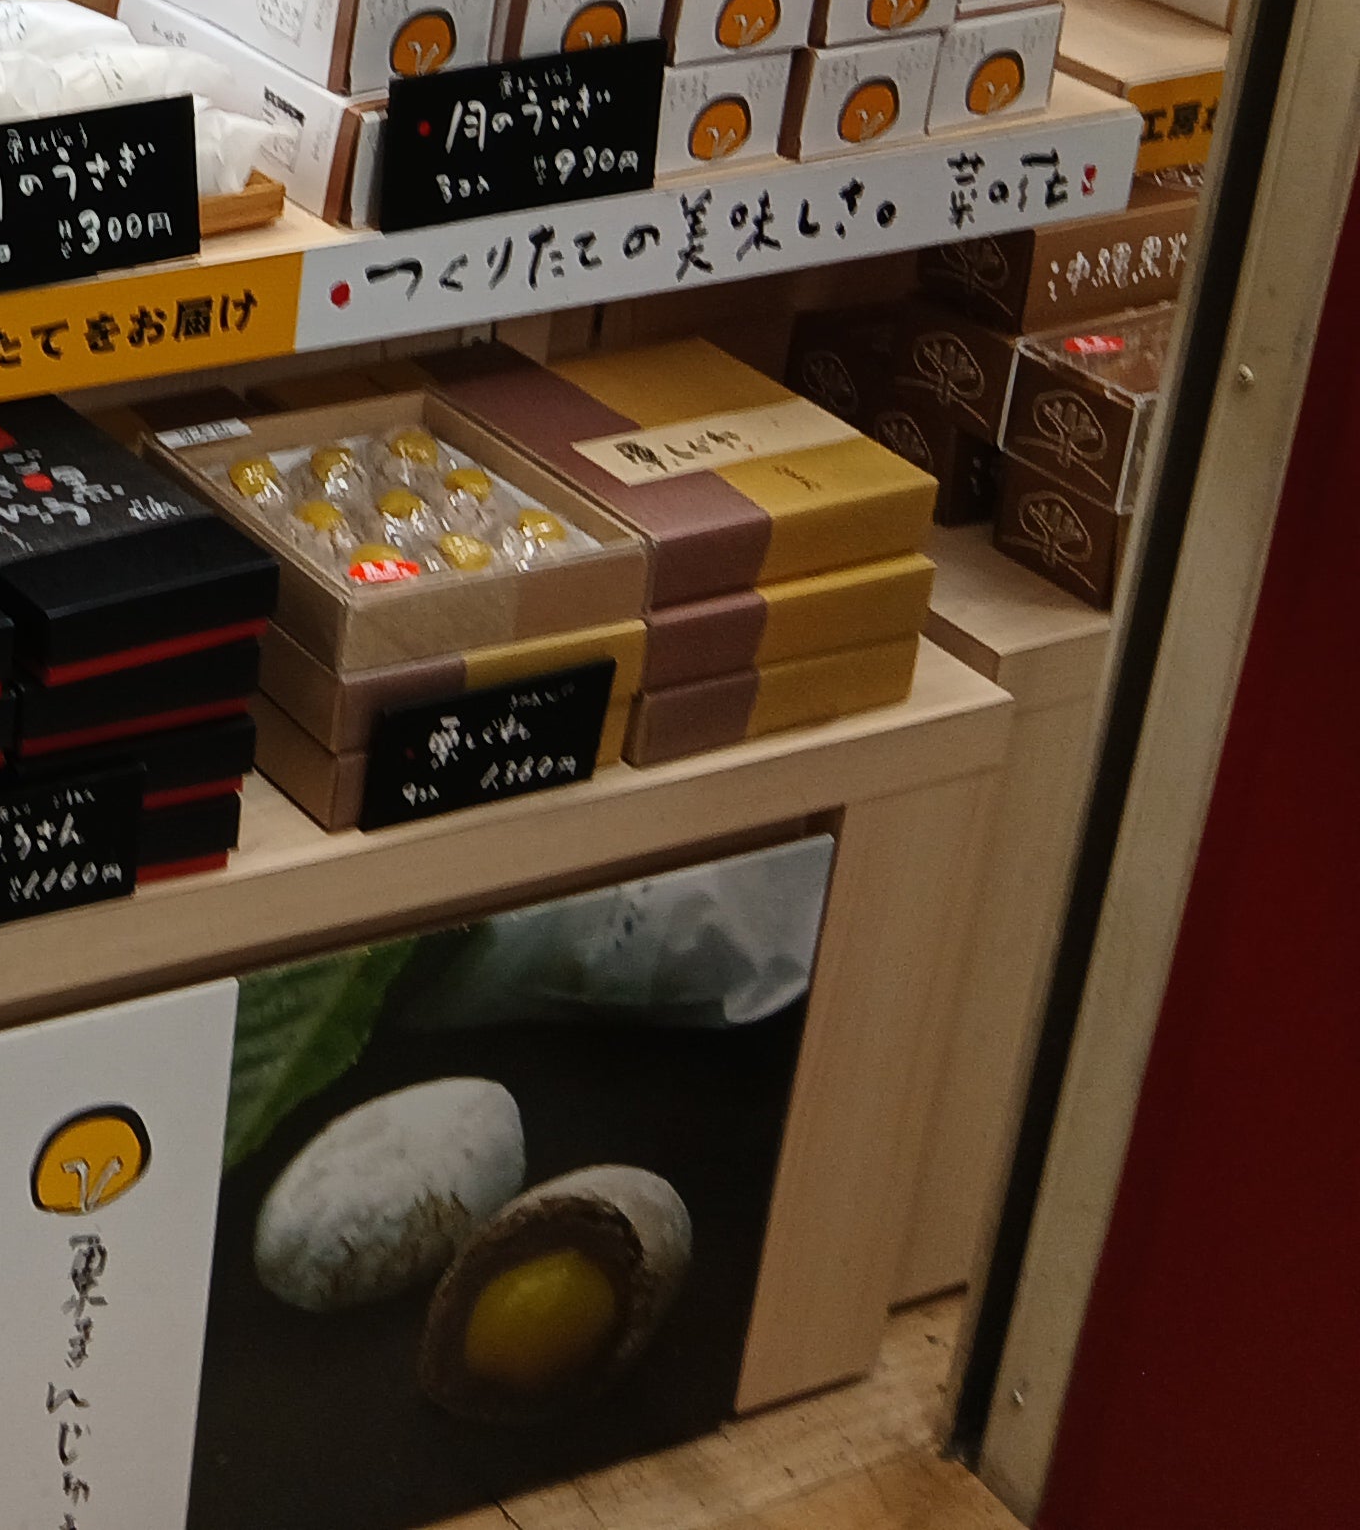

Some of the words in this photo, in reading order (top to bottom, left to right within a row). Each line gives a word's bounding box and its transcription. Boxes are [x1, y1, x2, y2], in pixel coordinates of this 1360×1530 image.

[444, 82, 612, 155] 月のうさぎ
[946, 148, 1070, 233] 菜の花
